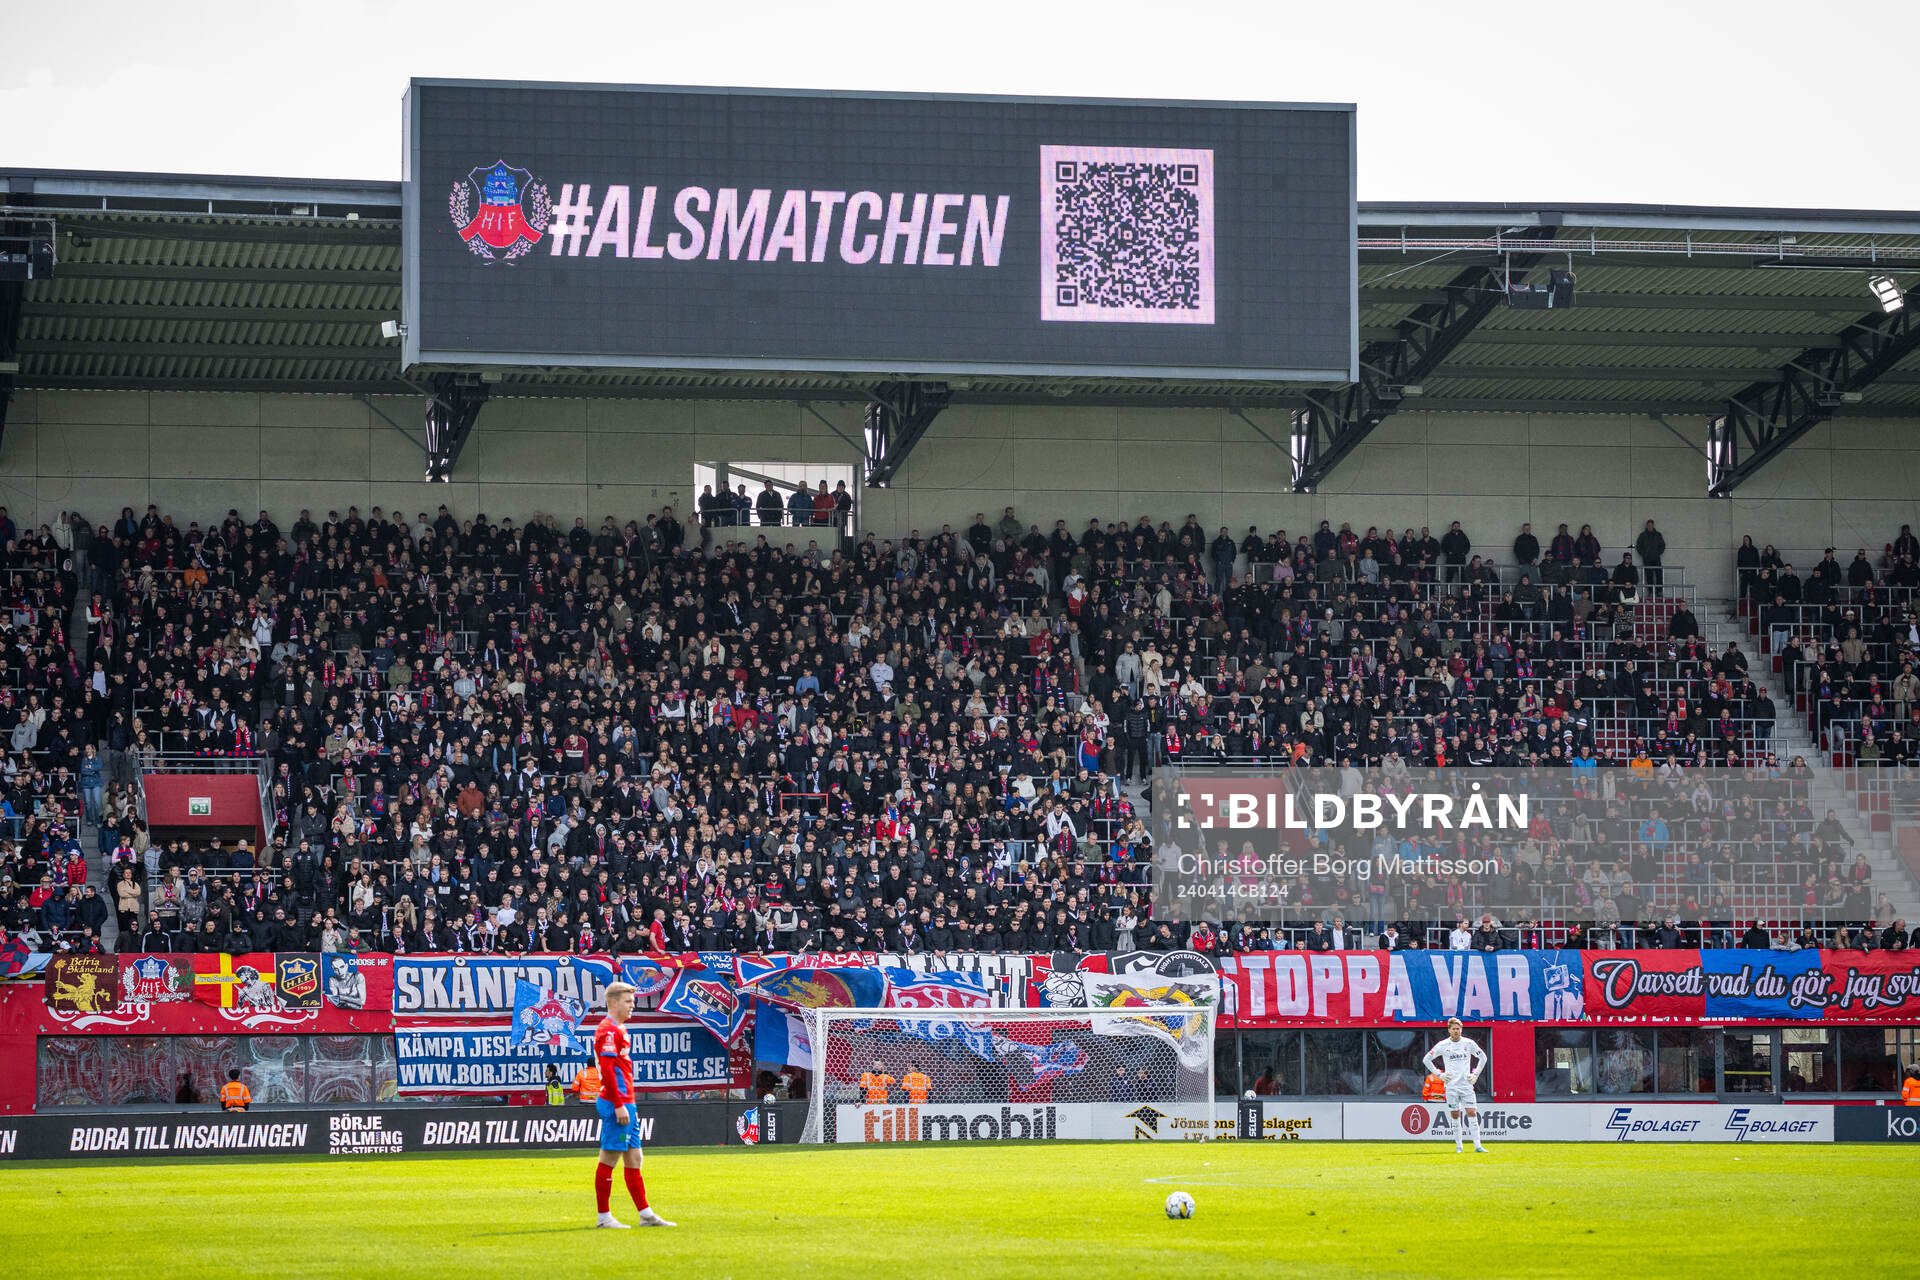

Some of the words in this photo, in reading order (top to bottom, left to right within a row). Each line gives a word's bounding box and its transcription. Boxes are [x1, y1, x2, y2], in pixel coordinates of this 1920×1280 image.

[548, 184, 1010, 267] #ALSMATCHEN
[66, 965, 115, 974] Skåneland
[68, 957, 100, 966] Befria
[348, 958, 376, 967] CHOOSE
[377, 958, 389, 967] HIF
[1170, 953, 1210, 969] POTENTIALS
[1220, 954, 1417, 1017] STOPPA
[1431, 954, 1532, 1017] VAR
[1592, 958, 1703, 1009] Oavsett
[1708, 966, 1749, 998] vad
[1754, 966, 1786, 997] du
[1841, 969, 1903, 1008] jag
[397, 1033, 466, 1058] KÄMPA
[660, 1032, 691, 1054] DIG
[329, 1113, 383, 1131] BÖRJE
[423, 1120, 481, 1145] BIDRA
[483, 1120, 520, 1144] TILL
[523, 1118, 655, 1143] INSAMLIN
[767, 1112, 776, 1141] SELECT
[864, 1106, 1057, 1143] tillmobil
[1248, 1108, 1257, 1137] SELECT
[1631, 1120, 1701, 1132] BOLAGET
[1750, 1120, 1819, 1132] BOLAGET
[70, 1127, 130, 1152] BIDRA
[132, 1125, 168, 1150] TILL
[173, 1123, 309, 1150] INSAMLINGEN
[329, 1130, 403, 1146] SALMING
